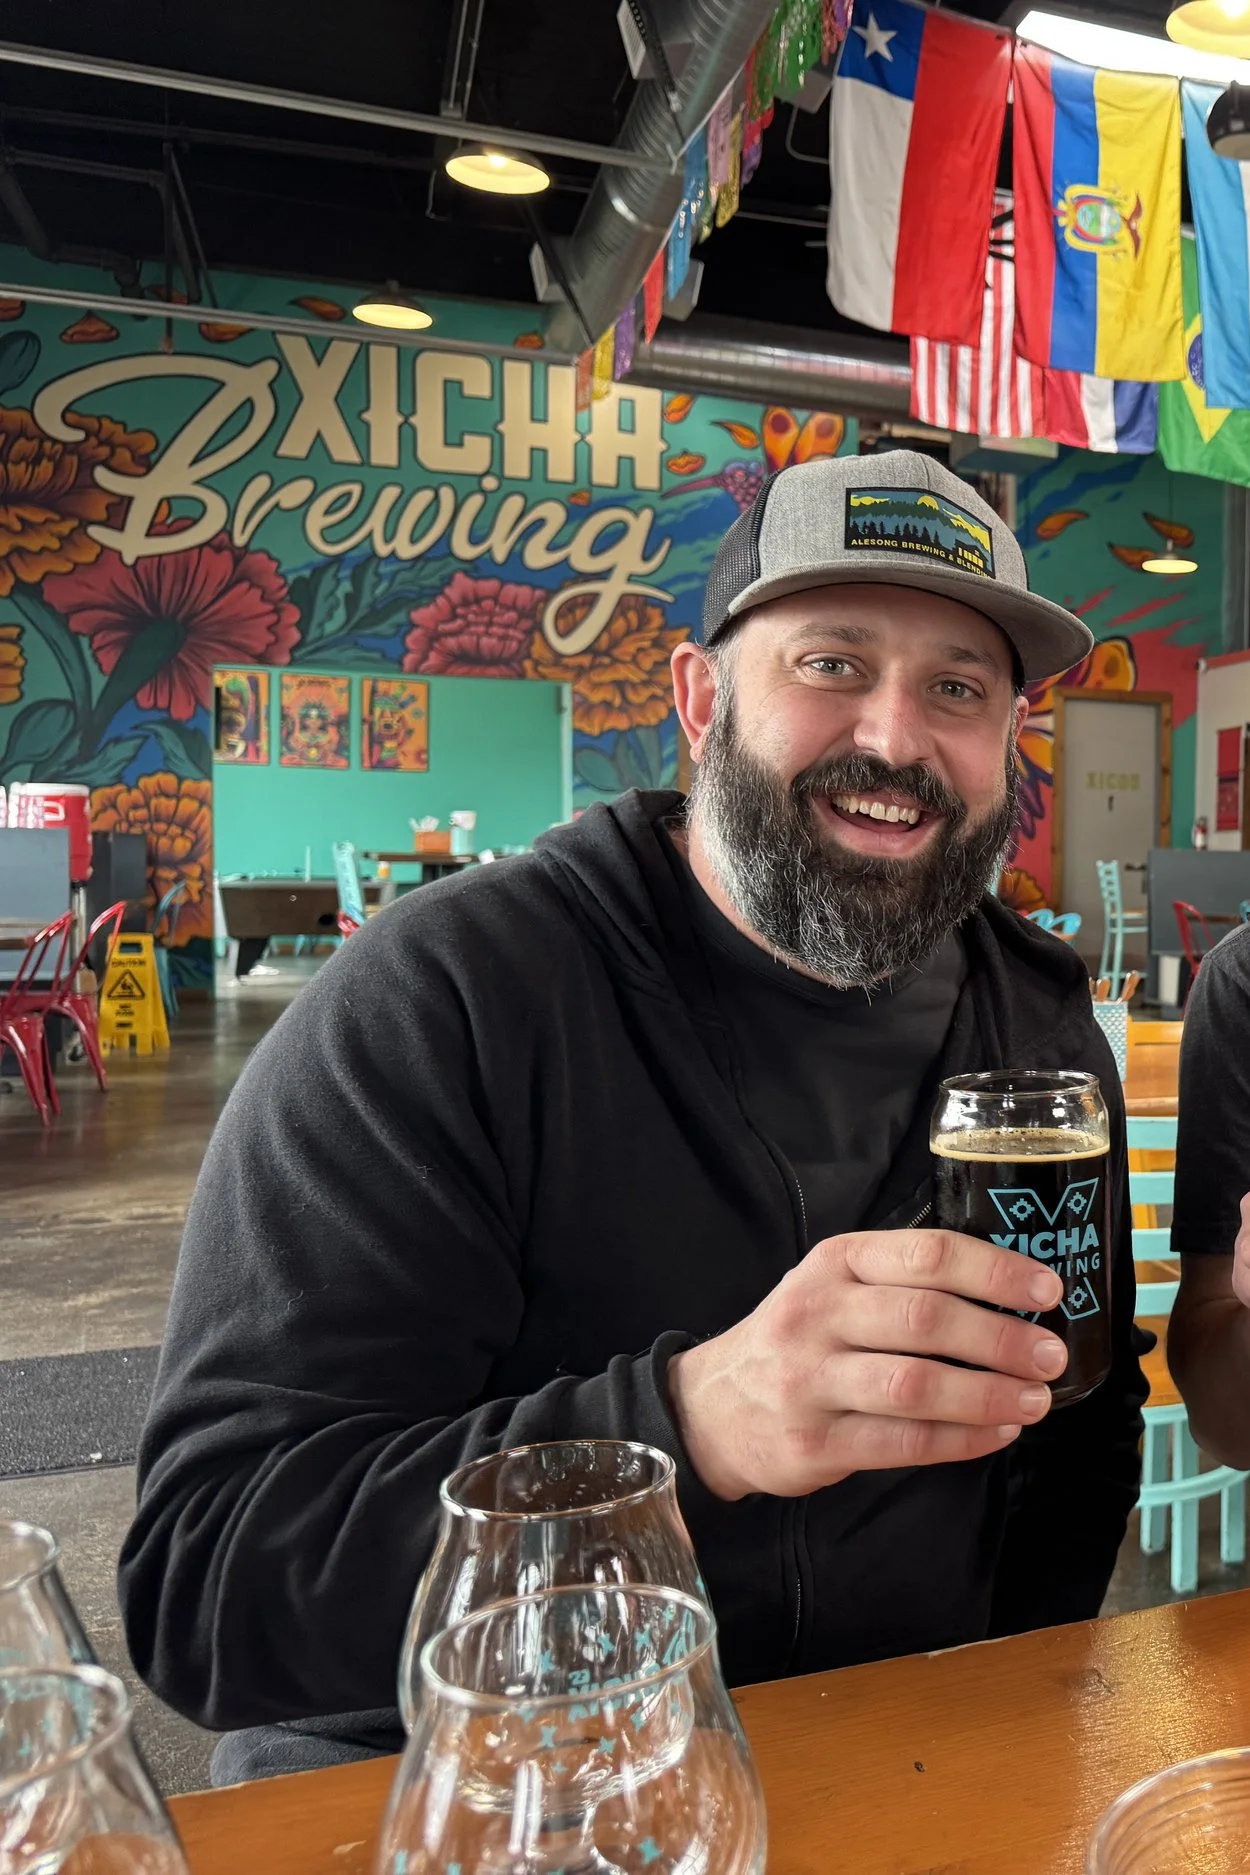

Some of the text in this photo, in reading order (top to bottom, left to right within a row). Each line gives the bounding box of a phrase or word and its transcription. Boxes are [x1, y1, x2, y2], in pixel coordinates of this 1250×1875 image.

[272, 331, 668, 491] XICHA
[34, 353, 675, 655] Brewing
[851, 538, 898, 547] ALESONG
[901, 541, 946, 558] BREWING
[956, 557, 991, 578] BLENDIN
